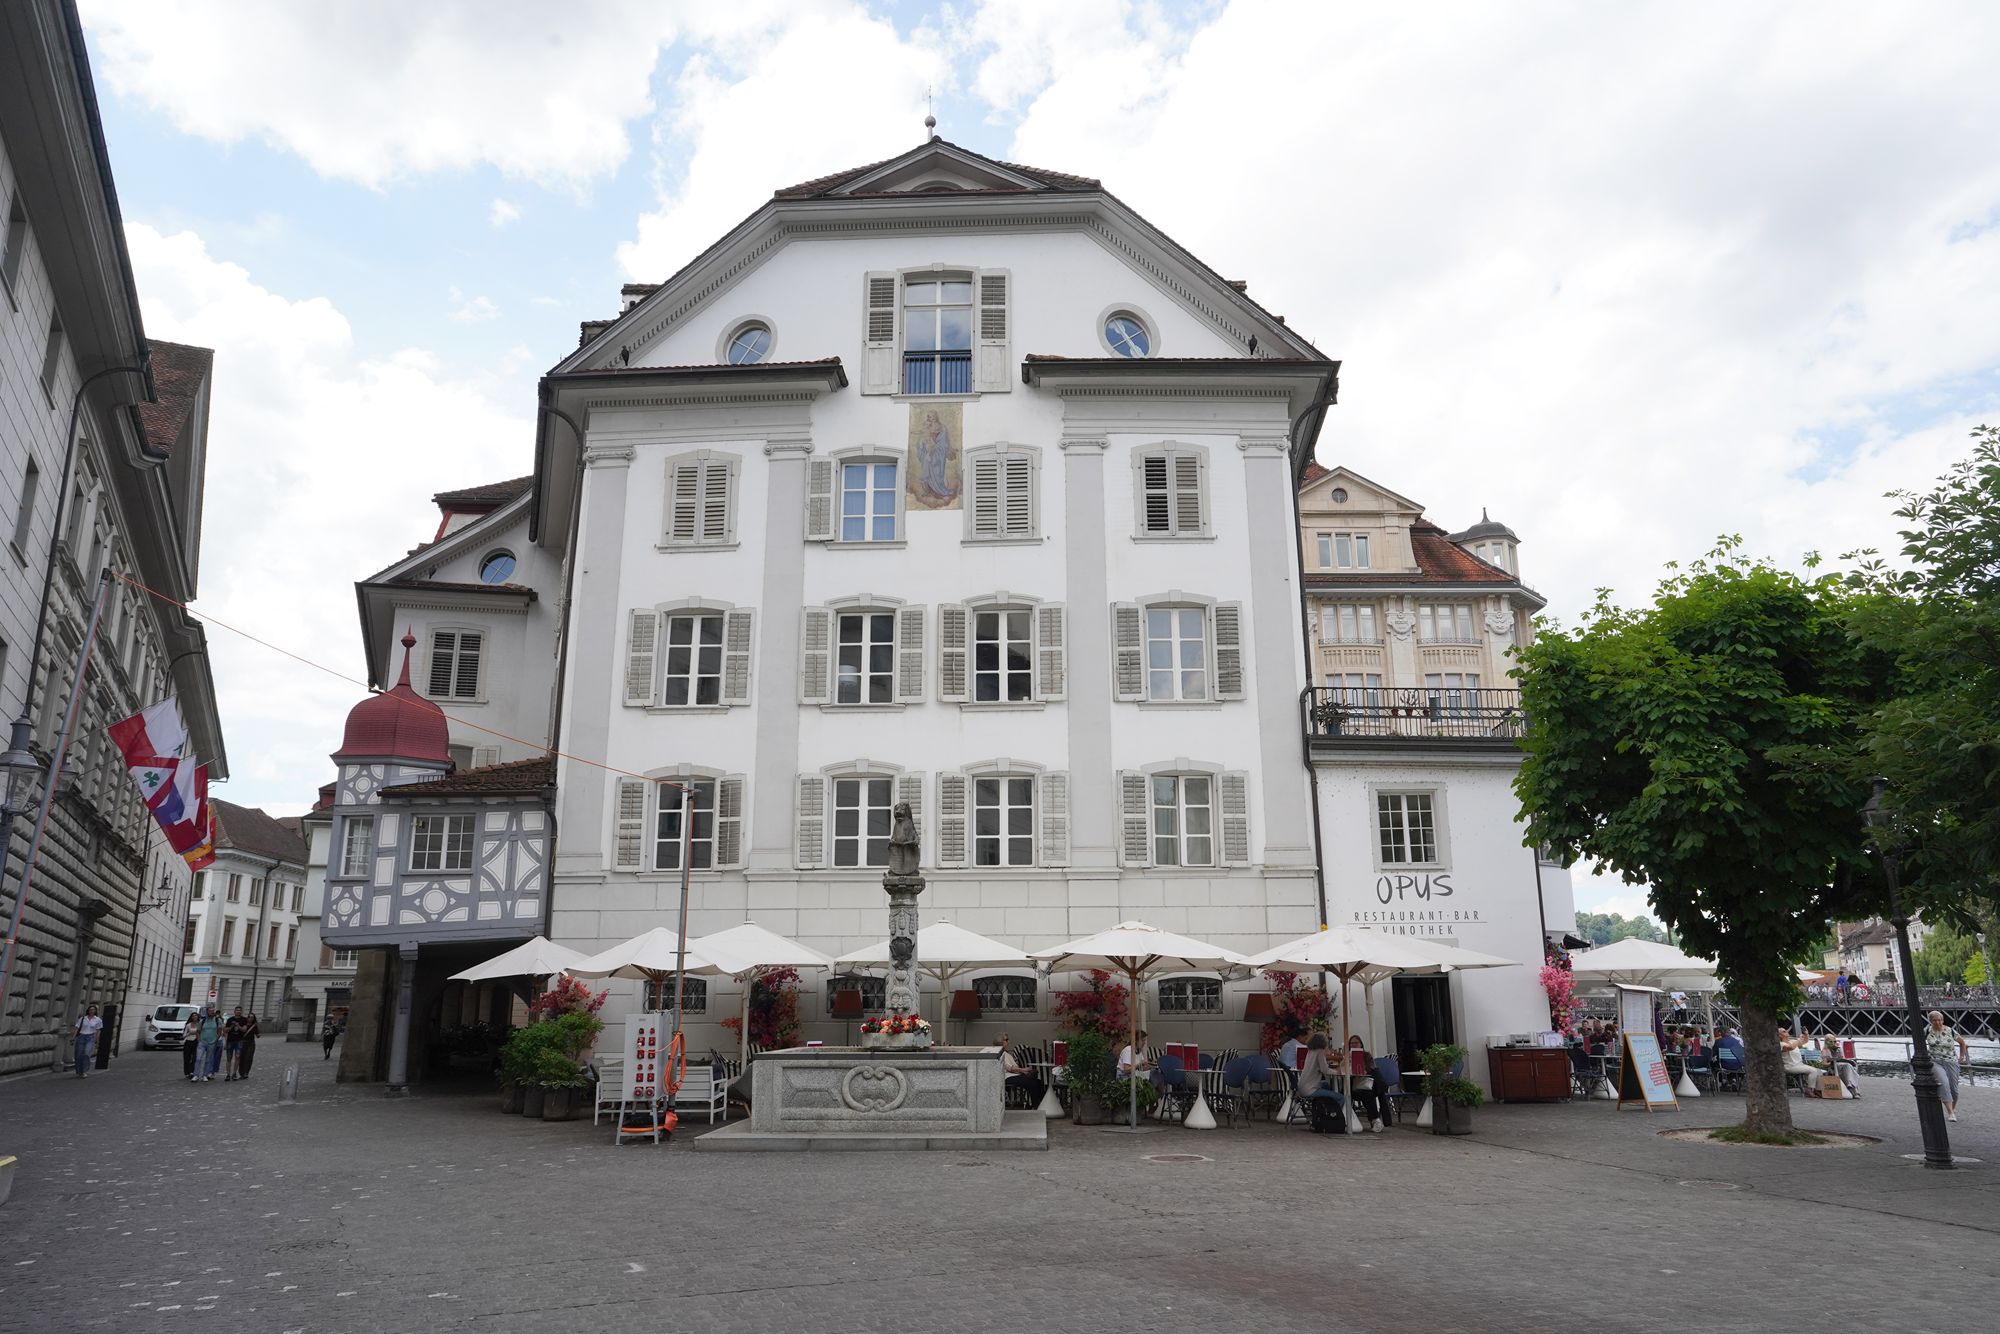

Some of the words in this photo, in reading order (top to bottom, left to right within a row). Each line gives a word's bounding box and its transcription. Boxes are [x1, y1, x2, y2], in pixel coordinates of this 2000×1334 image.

[1376, 874, 1453, 904] OPUS
[1454, 910, 1479, 920] BAR
[1382, 925, 1453, 935] VINOTHEK
